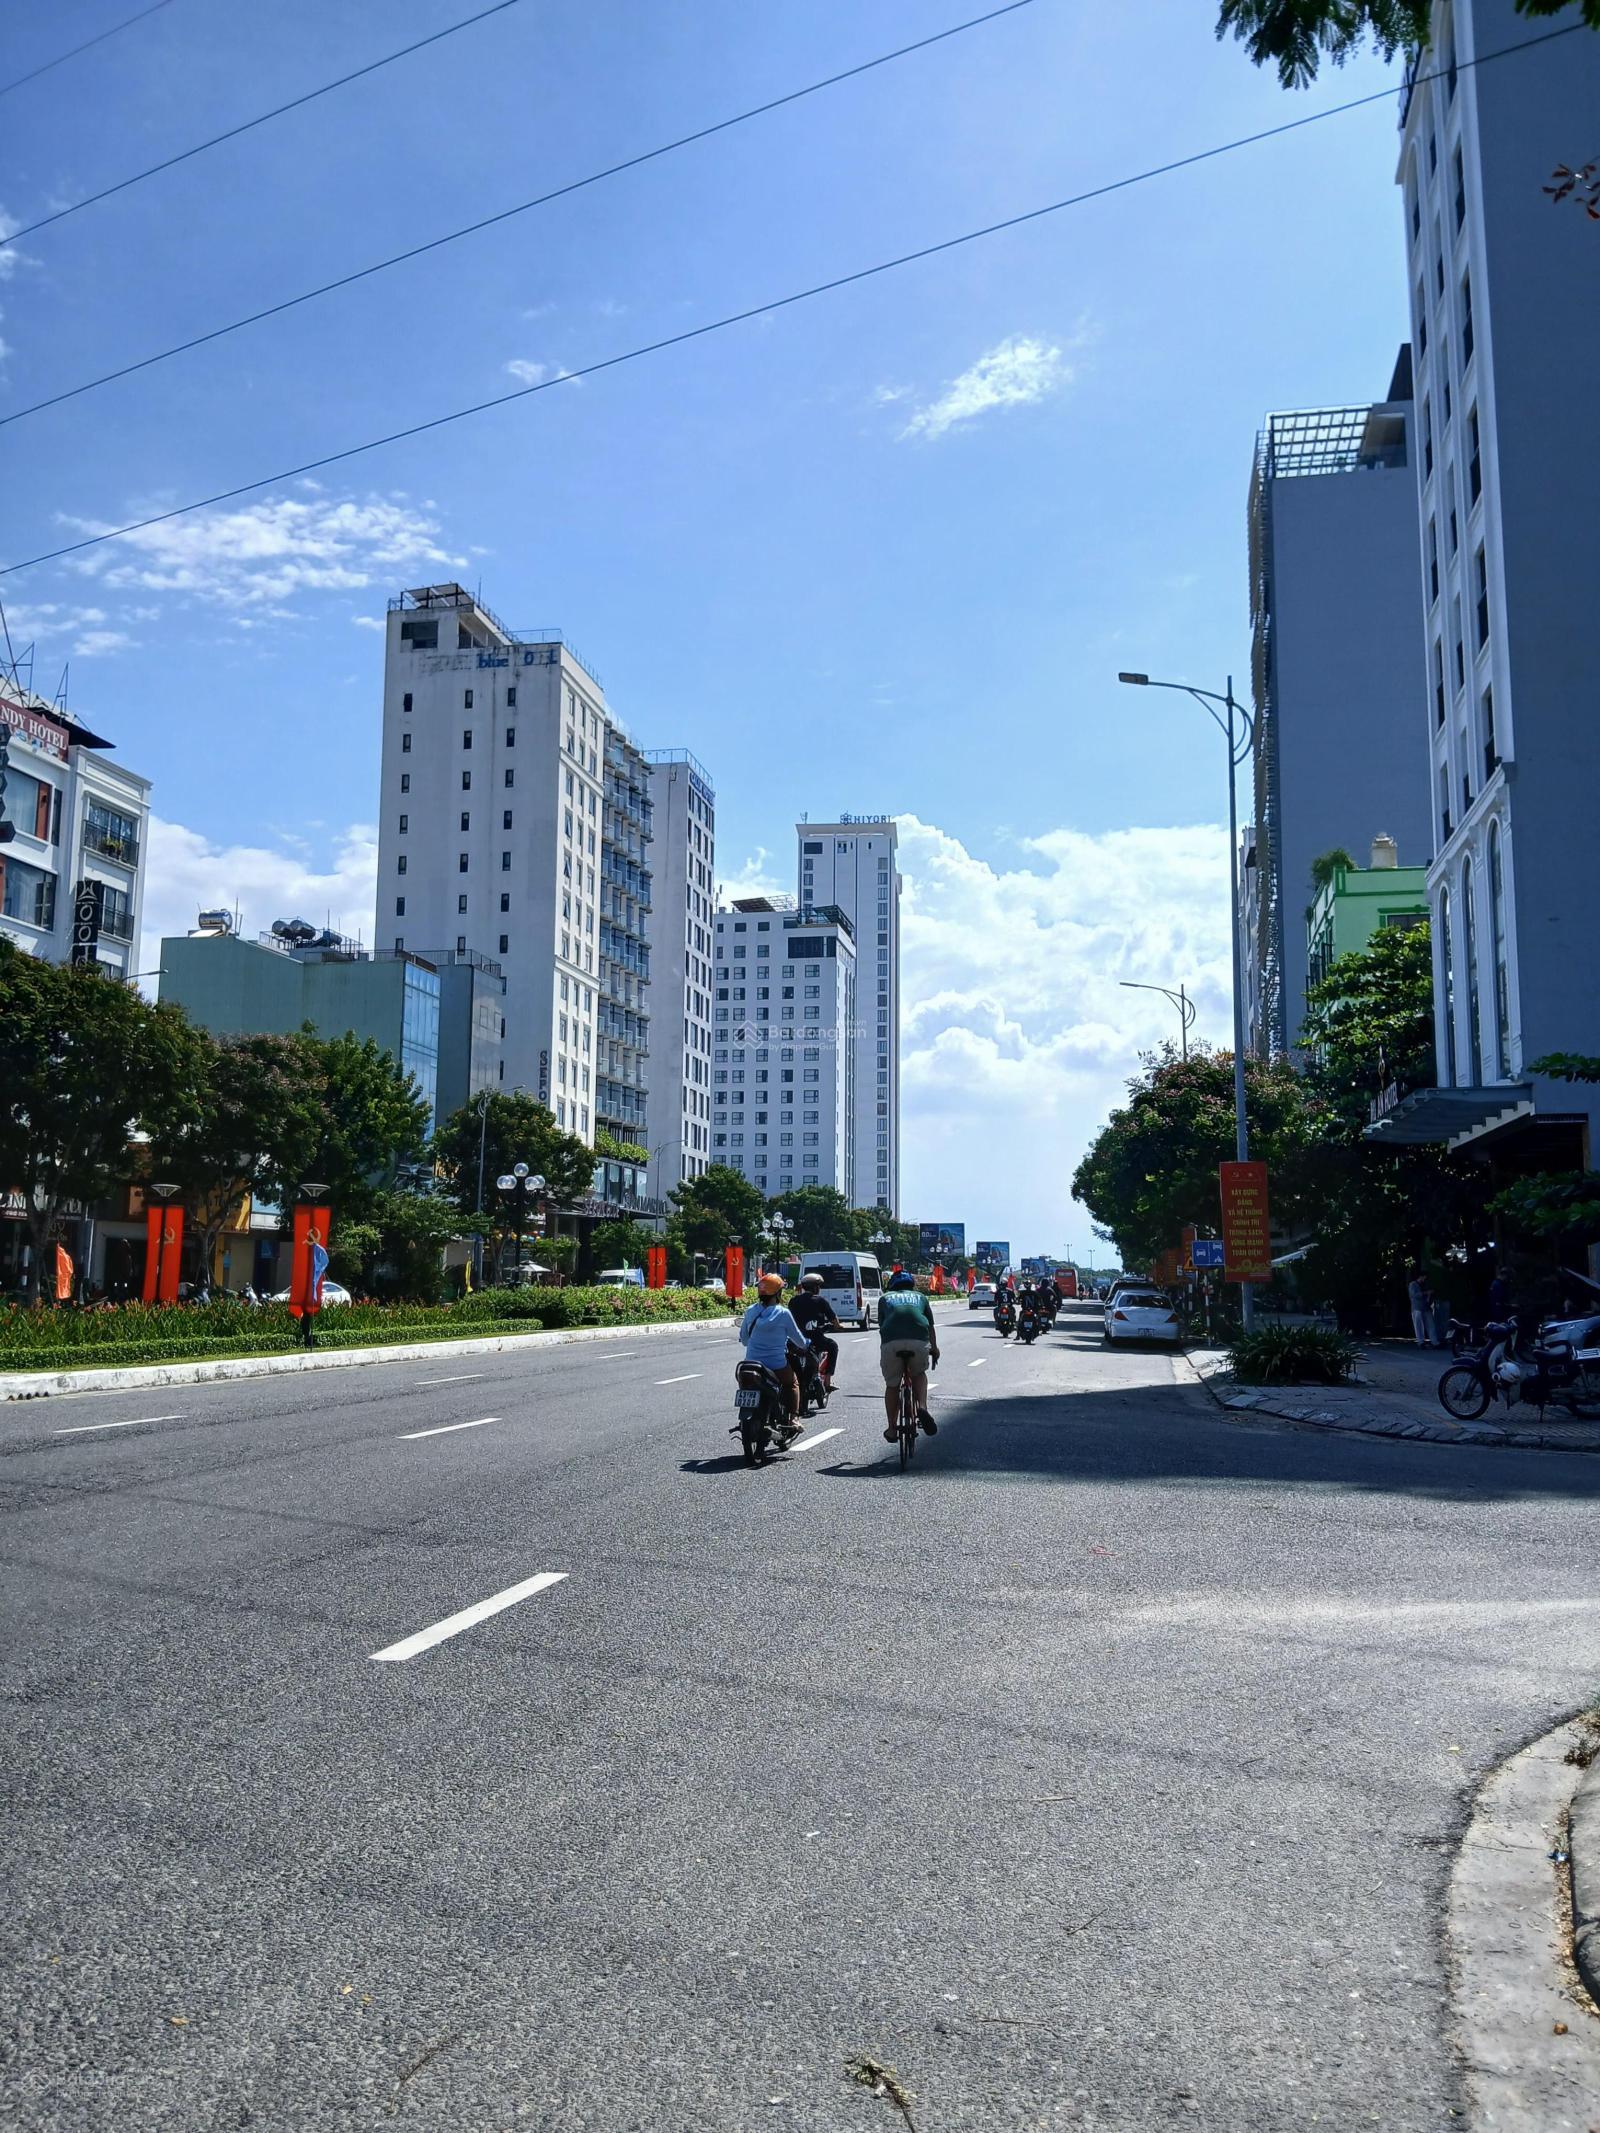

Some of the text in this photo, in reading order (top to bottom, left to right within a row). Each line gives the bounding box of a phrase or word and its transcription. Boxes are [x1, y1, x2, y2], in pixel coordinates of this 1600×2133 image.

[477, 653, 509, 669] blue
[29, 718, 67, 751] HOTEL
[854, 815, 891, 824] HIYORI
